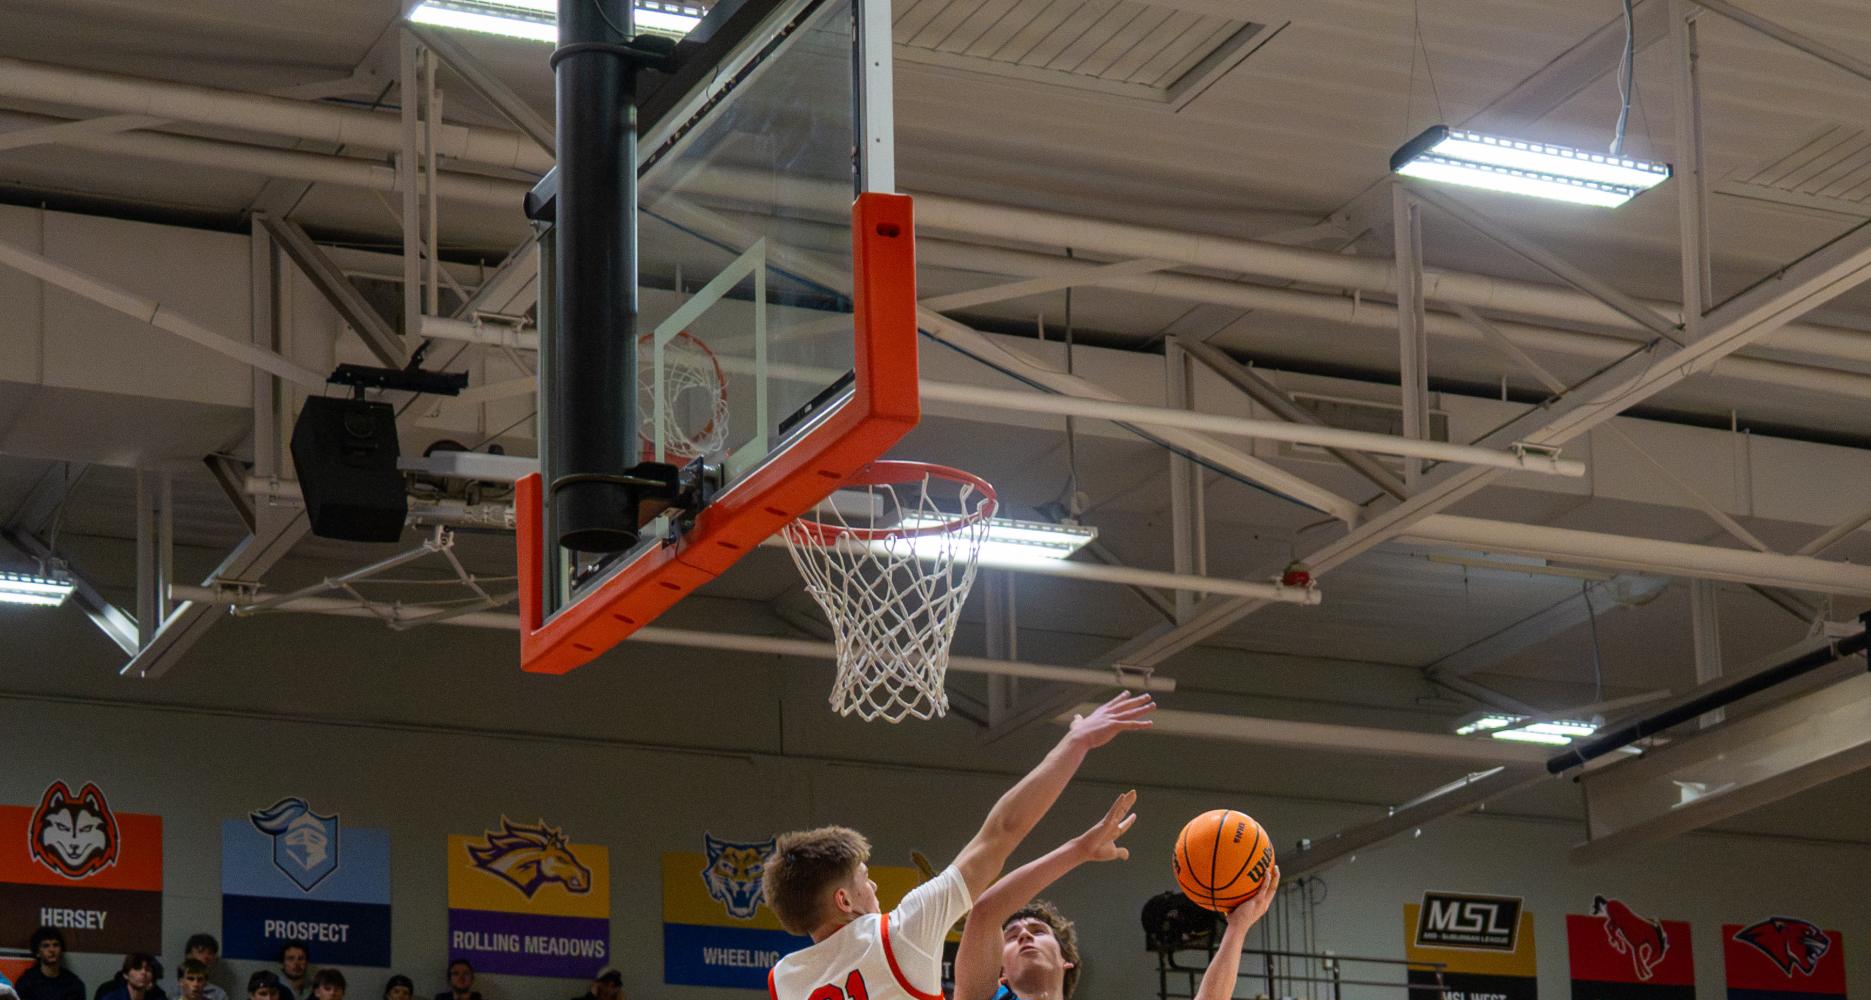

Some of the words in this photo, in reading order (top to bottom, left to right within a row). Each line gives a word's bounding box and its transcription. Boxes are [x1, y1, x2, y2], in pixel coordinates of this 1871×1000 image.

[40, 906, 107, 930] HERSEY
[1427, 899, 1510, 934] MSL
[264, 919, 349, 943] PROSPECT
[452, 930, 521, 954] ROLLING
[524, 934, 606, 959] MEADOWS
[703, 946, 779, 969] WHEELING
